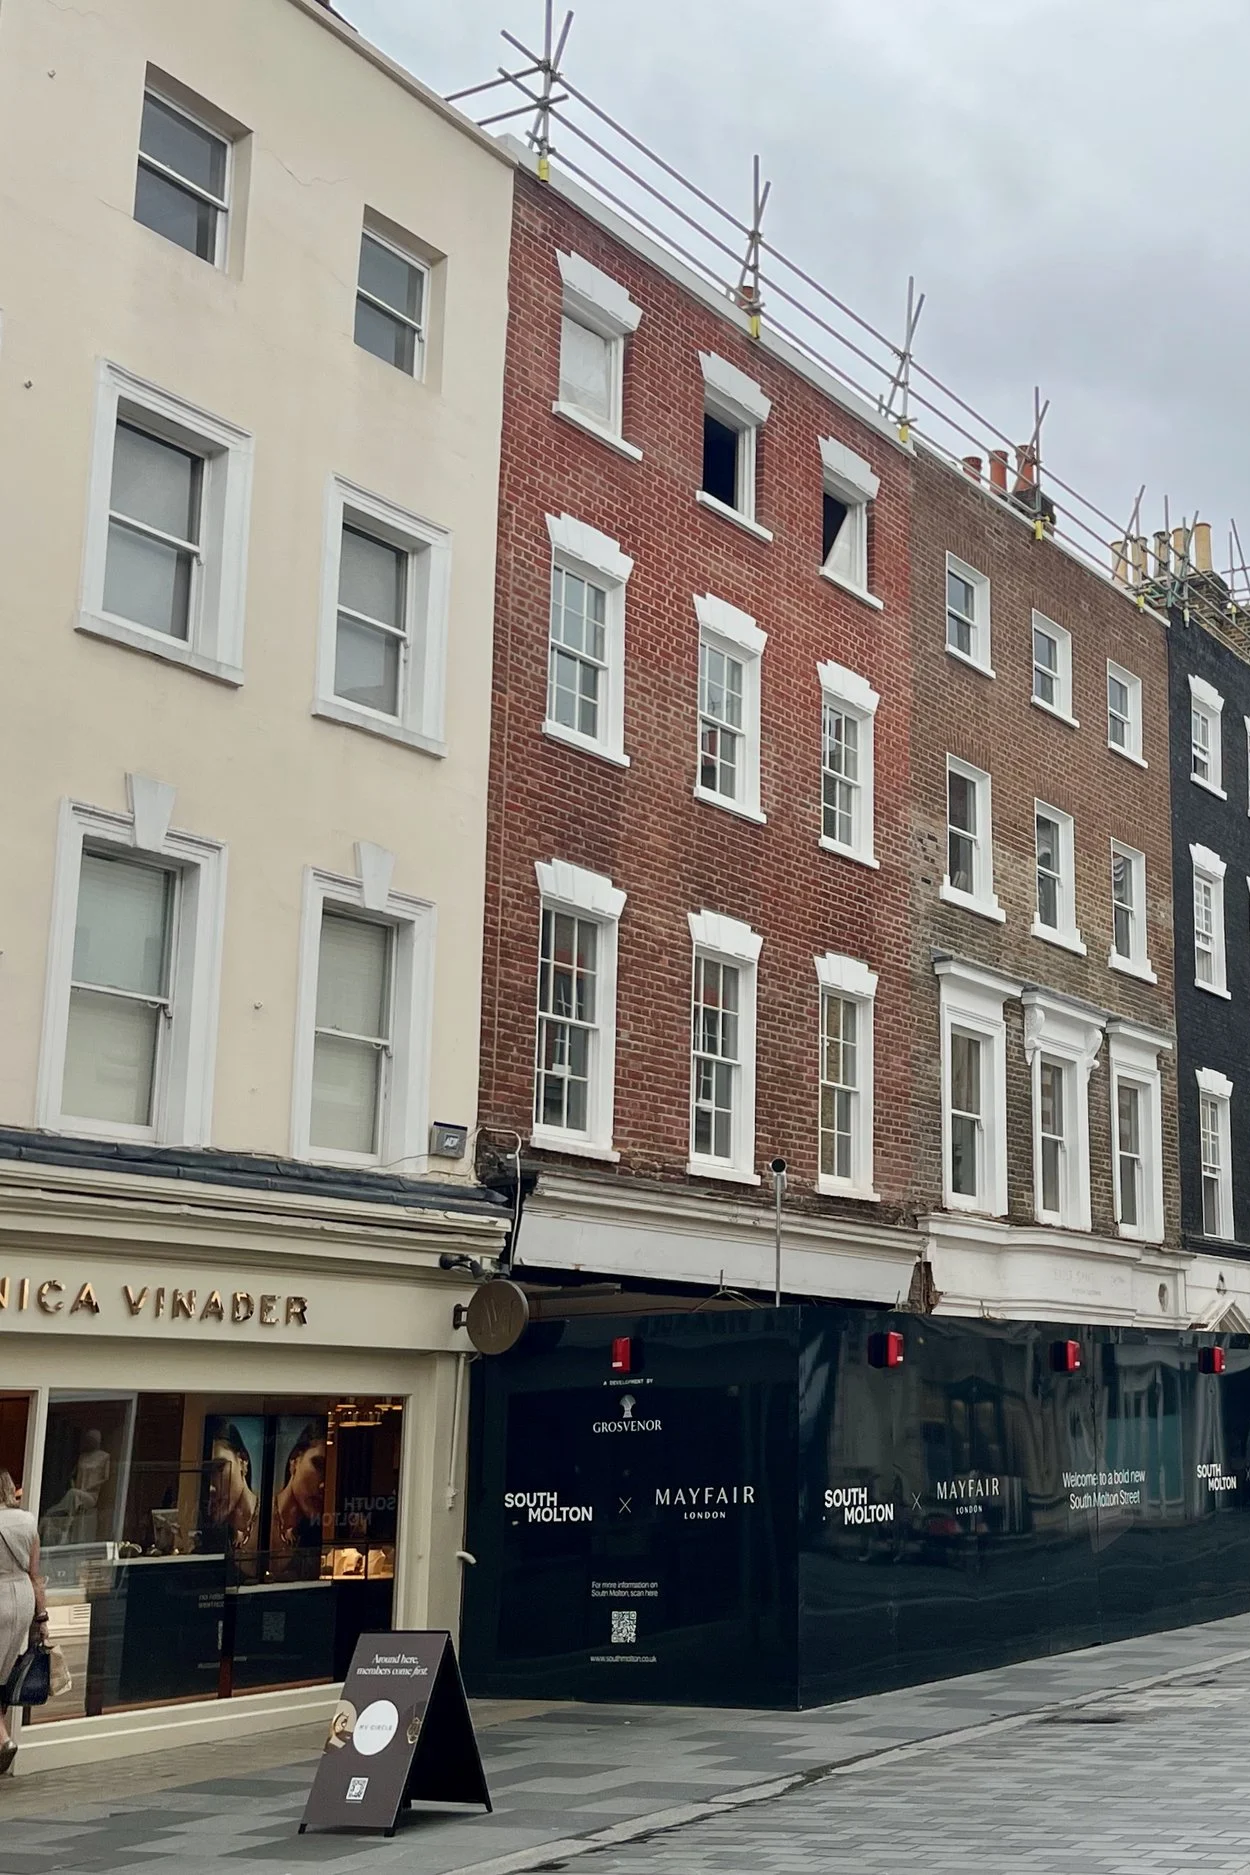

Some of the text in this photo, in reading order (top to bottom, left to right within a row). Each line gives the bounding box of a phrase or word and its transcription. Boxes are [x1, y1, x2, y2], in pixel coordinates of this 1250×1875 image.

[122, 1284, 308, 1326] VINADER
[592, 1419, 662, 1433] GROSVENOR
[1062, 1468, 1146, 1488] Welcome to a bold new
[1196, 1463, 1222, 1478] SOUTH
[936, 1477, 1000, 1500] MAYFAIR
[1208, 1475, 1237, 1491] MOLTON
[504, 1492, 558, 1508] SOUTH
[655, 1486, 755, 1506] MAYFAIR
[824, 1487, 868, 1508] SOUTH
[1069, 1489, 1141, 1510] South Molton Street
[528, 1506, 593, 1522] MOLTON
[684, 1511, 726, 1520] LONDON
[844, 1503, 894, 1525] MOLTON
[955, 1504, 983, 1515] LONDON
[591, 1581, 601, 1589] For
[617, 1581, 649, 1589] information
[591, 1589, 608, 1597] South
[644, 1589, 659, 1597] here
[372, 1653, 419, 1665] Around here,
[356, 1665, 391, 1675] members
[391, 1667, 413, 1675] come
